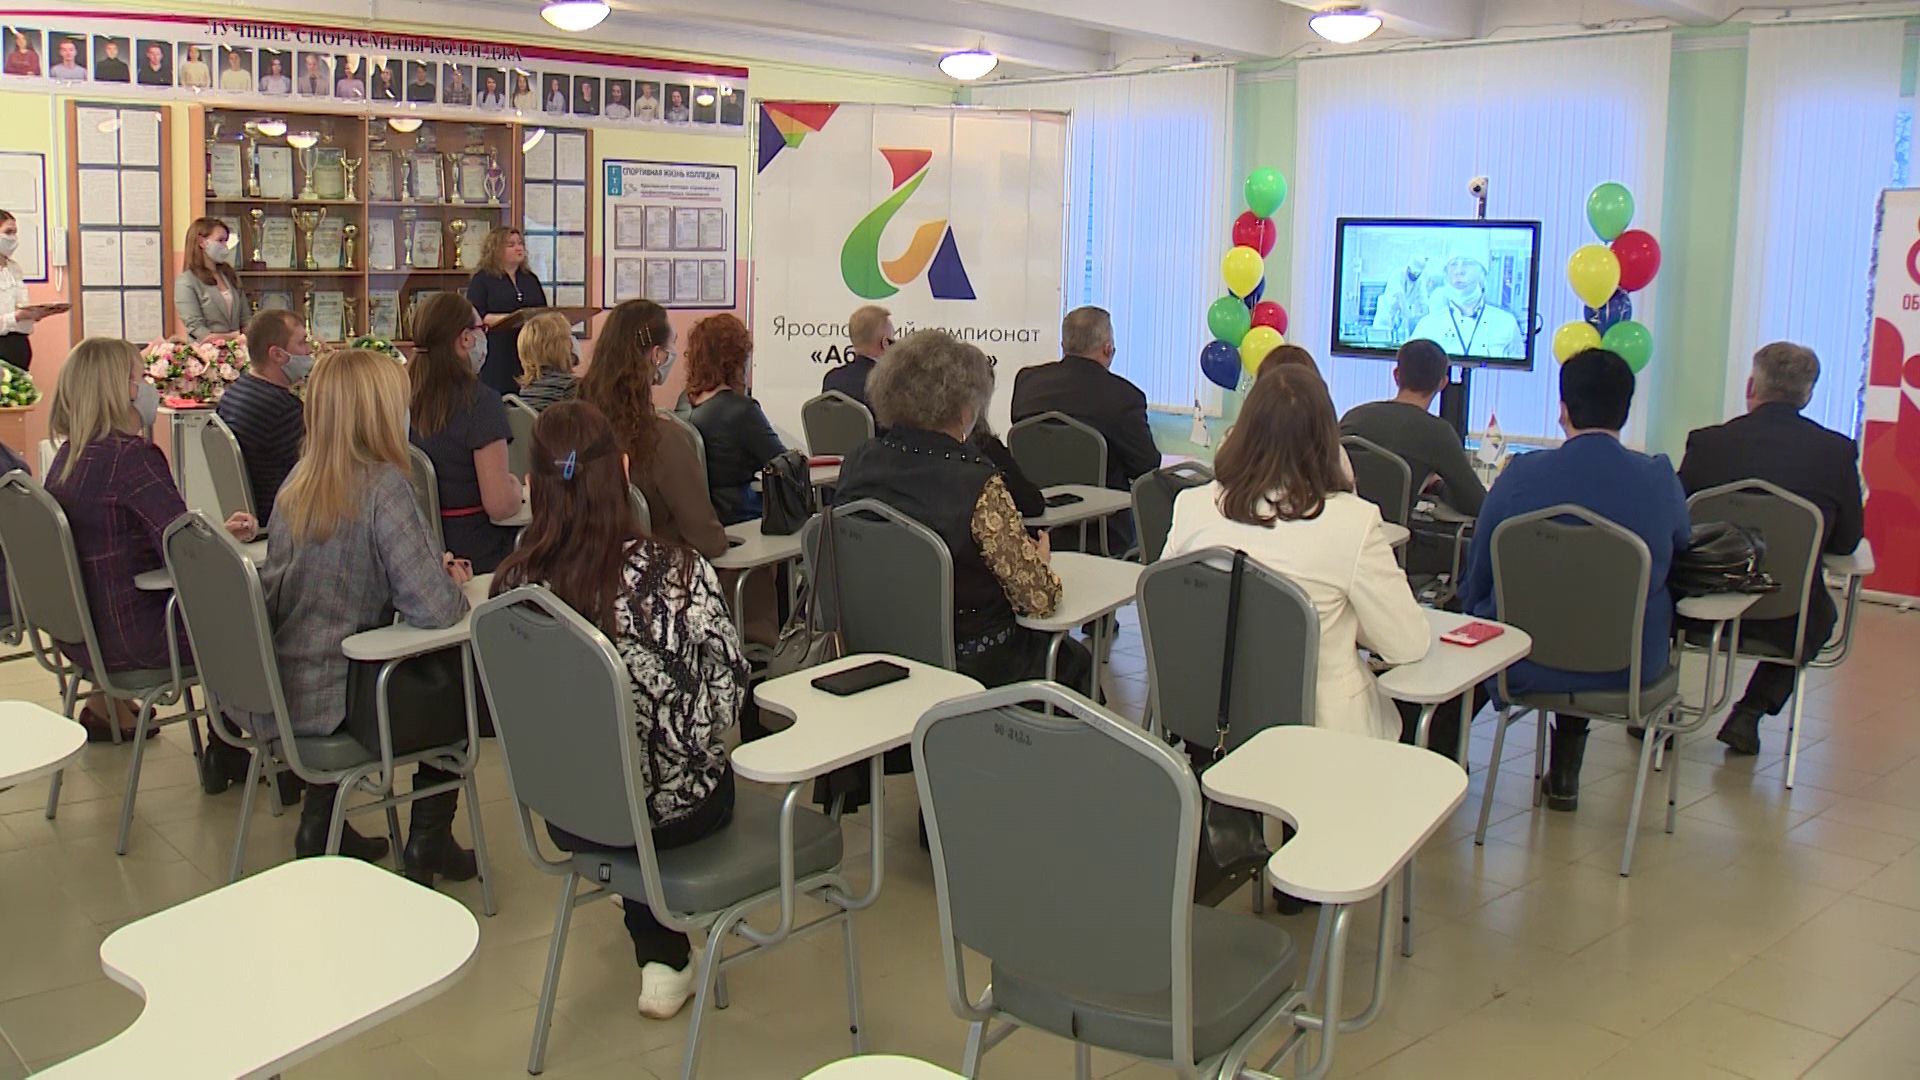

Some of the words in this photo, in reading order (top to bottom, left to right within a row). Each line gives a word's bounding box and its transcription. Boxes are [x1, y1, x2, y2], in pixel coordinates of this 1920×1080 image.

[205, 20, 290, 42] ЛУЧШИЕ
[296, 29, 425, 53] СПОРТСМЕНЫ
[430, 40, 523, 62] КОЛЛЕДЖА
[773, 315, 915, 341] Ярослаий
[923, 326, 1040, 342] мпионат
